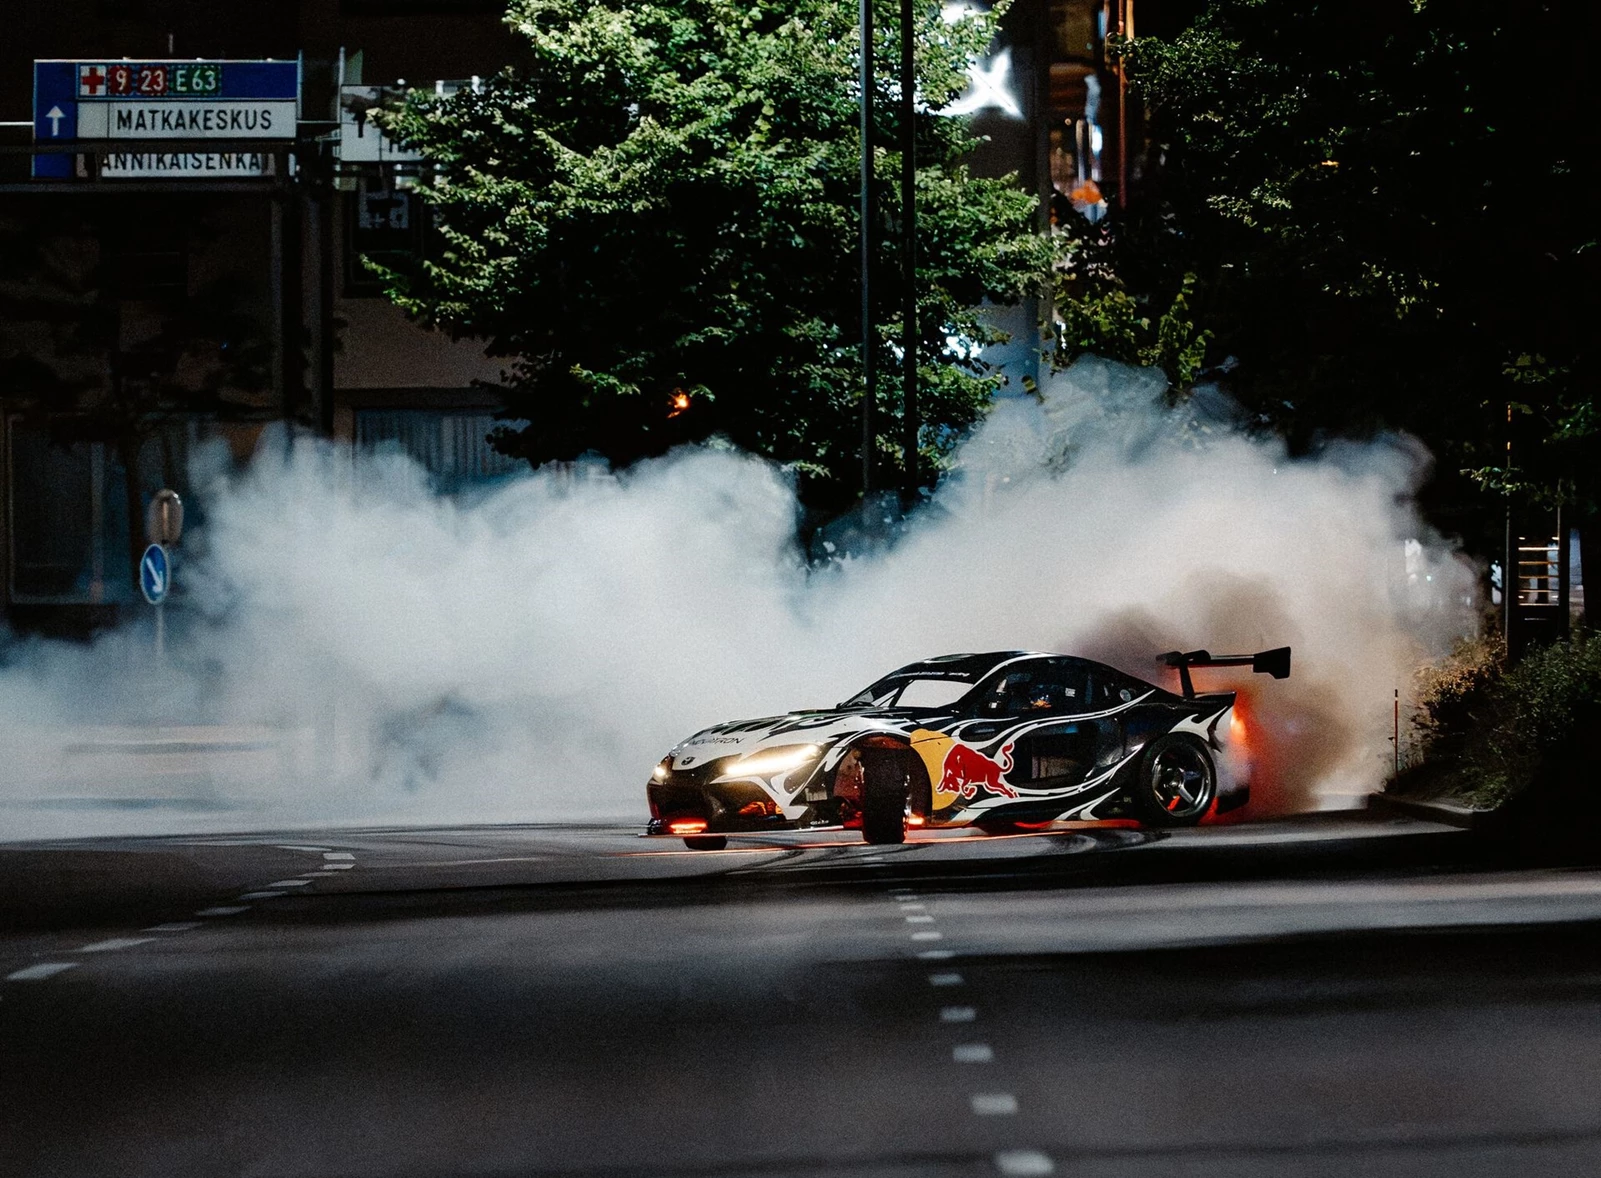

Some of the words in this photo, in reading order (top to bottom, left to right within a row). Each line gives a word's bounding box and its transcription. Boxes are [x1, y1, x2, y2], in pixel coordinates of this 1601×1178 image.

[115, 70, 127, 90] 9
[140, 70, 164, 90] 23
[116, 109, 272, 130] MATKAKESKUS
